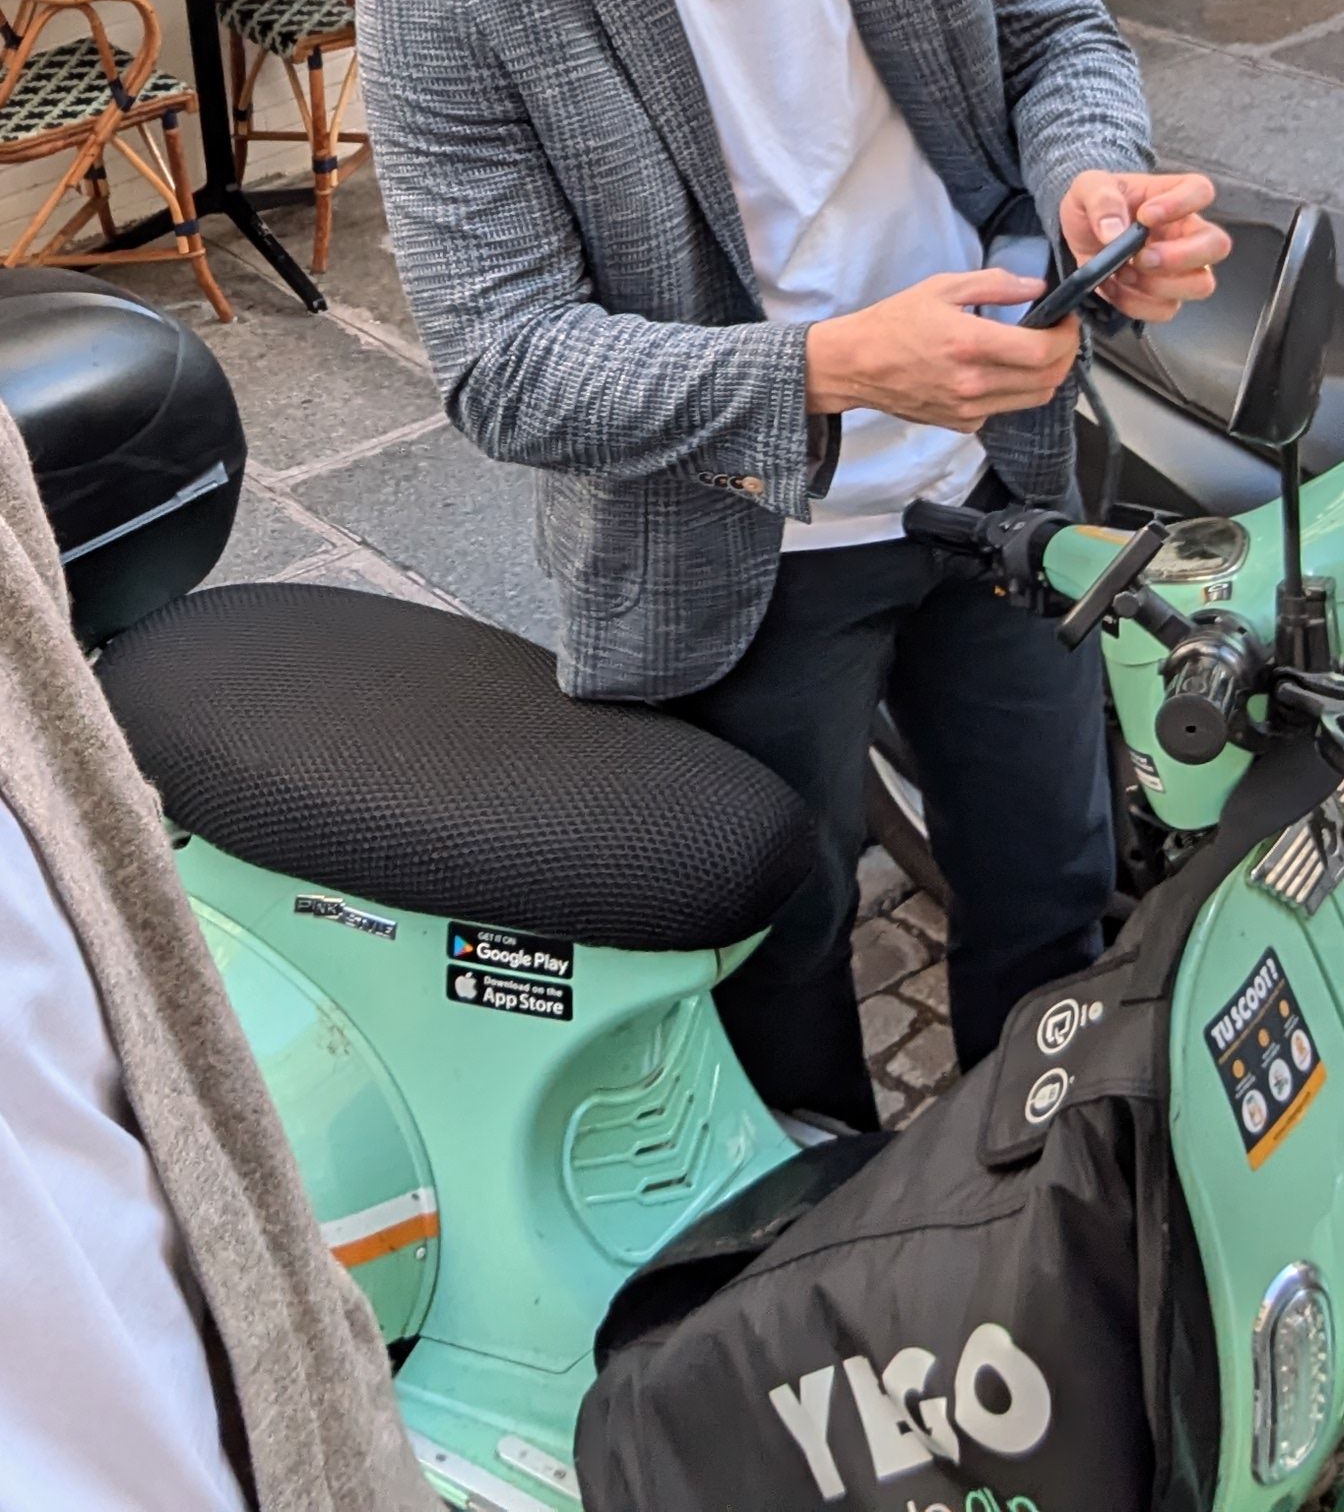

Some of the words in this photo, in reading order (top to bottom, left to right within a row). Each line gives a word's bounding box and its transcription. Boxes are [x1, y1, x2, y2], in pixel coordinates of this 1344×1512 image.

[477, 931, 494, 942] GET
[502, 935, 517, 946] ON
[476, 942, 532, 968] Google
[533, 952, 569, 976] Play
[483, 975, 530, 992] Download
[532, 985, 545, 995] on
[546, 987, 564, 998] the
[482, 987, 518, 1009] App
[518, 993, 564, 1015] Store
[1210, 1014, 1235, 1051] TU
[1229, 957, 1280, 1033] SCOOT?
